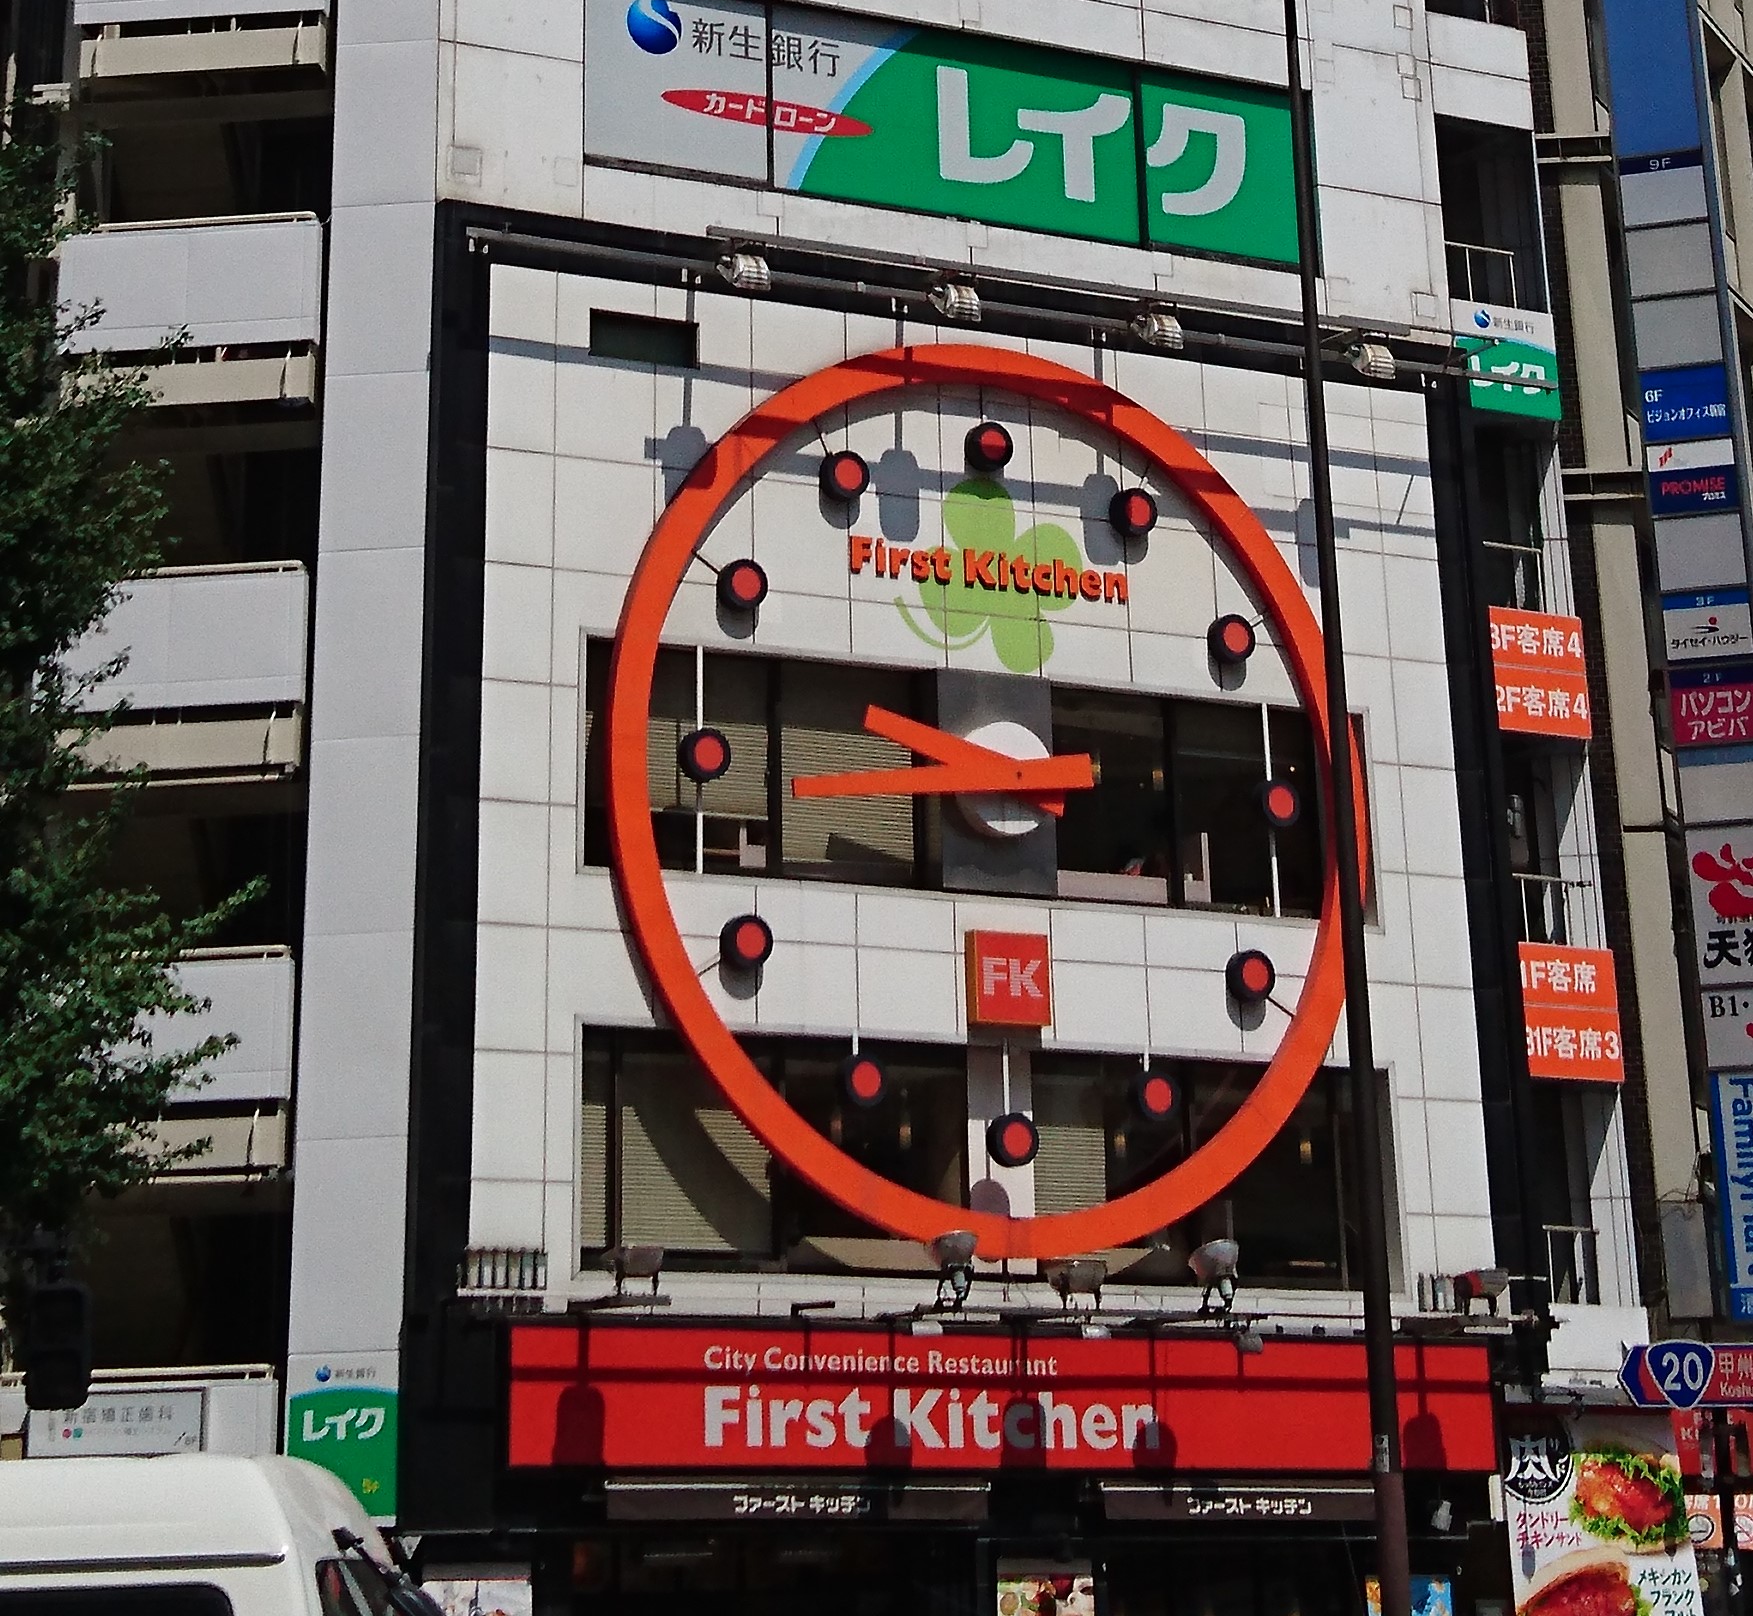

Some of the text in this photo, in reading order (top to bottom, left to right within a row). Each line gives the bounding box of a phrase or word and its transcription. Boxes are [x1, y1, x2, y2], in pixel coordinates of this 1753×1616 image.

[691, 17, 840, 78] 新生銀行
[703, 92, 837, 134] カードローン
[936, 65, 1248, 217] レイク
[1649, 157, 1671, 171] 9F
[1644, 389, 1664, 403] 6F
[1661, 477, 1726, 496] PROMISE
[848, 534, 1128, 605] First Kitchen
[1680, 689, 1752, 717] パソコン
[1688, 715, 1749, 741] アビバ
[1703, 928, 1753, 969] 天
[981, 956, 1044, 999] FK
[703, 1345, 1058, 1377] City Convenience Restaurant
[1661, 1351, 1704, 1391] 20
[303, 1406, 386, 1442] レイク
[704, 1384, 1160, 1451] First Kitchen
[733, 1494, 871, 1515] ファースト キッチン
[1187, 1496, 1312, 1515] ファースト キッチン
[1516, 1510, 1569, 1530] タンドリー
[1516, 1530, 1582, 1550] チキンサンド
[1638, 1567, 1692, 1586] メキシカン
[1650, 1588, 1695, 1608] フランク
